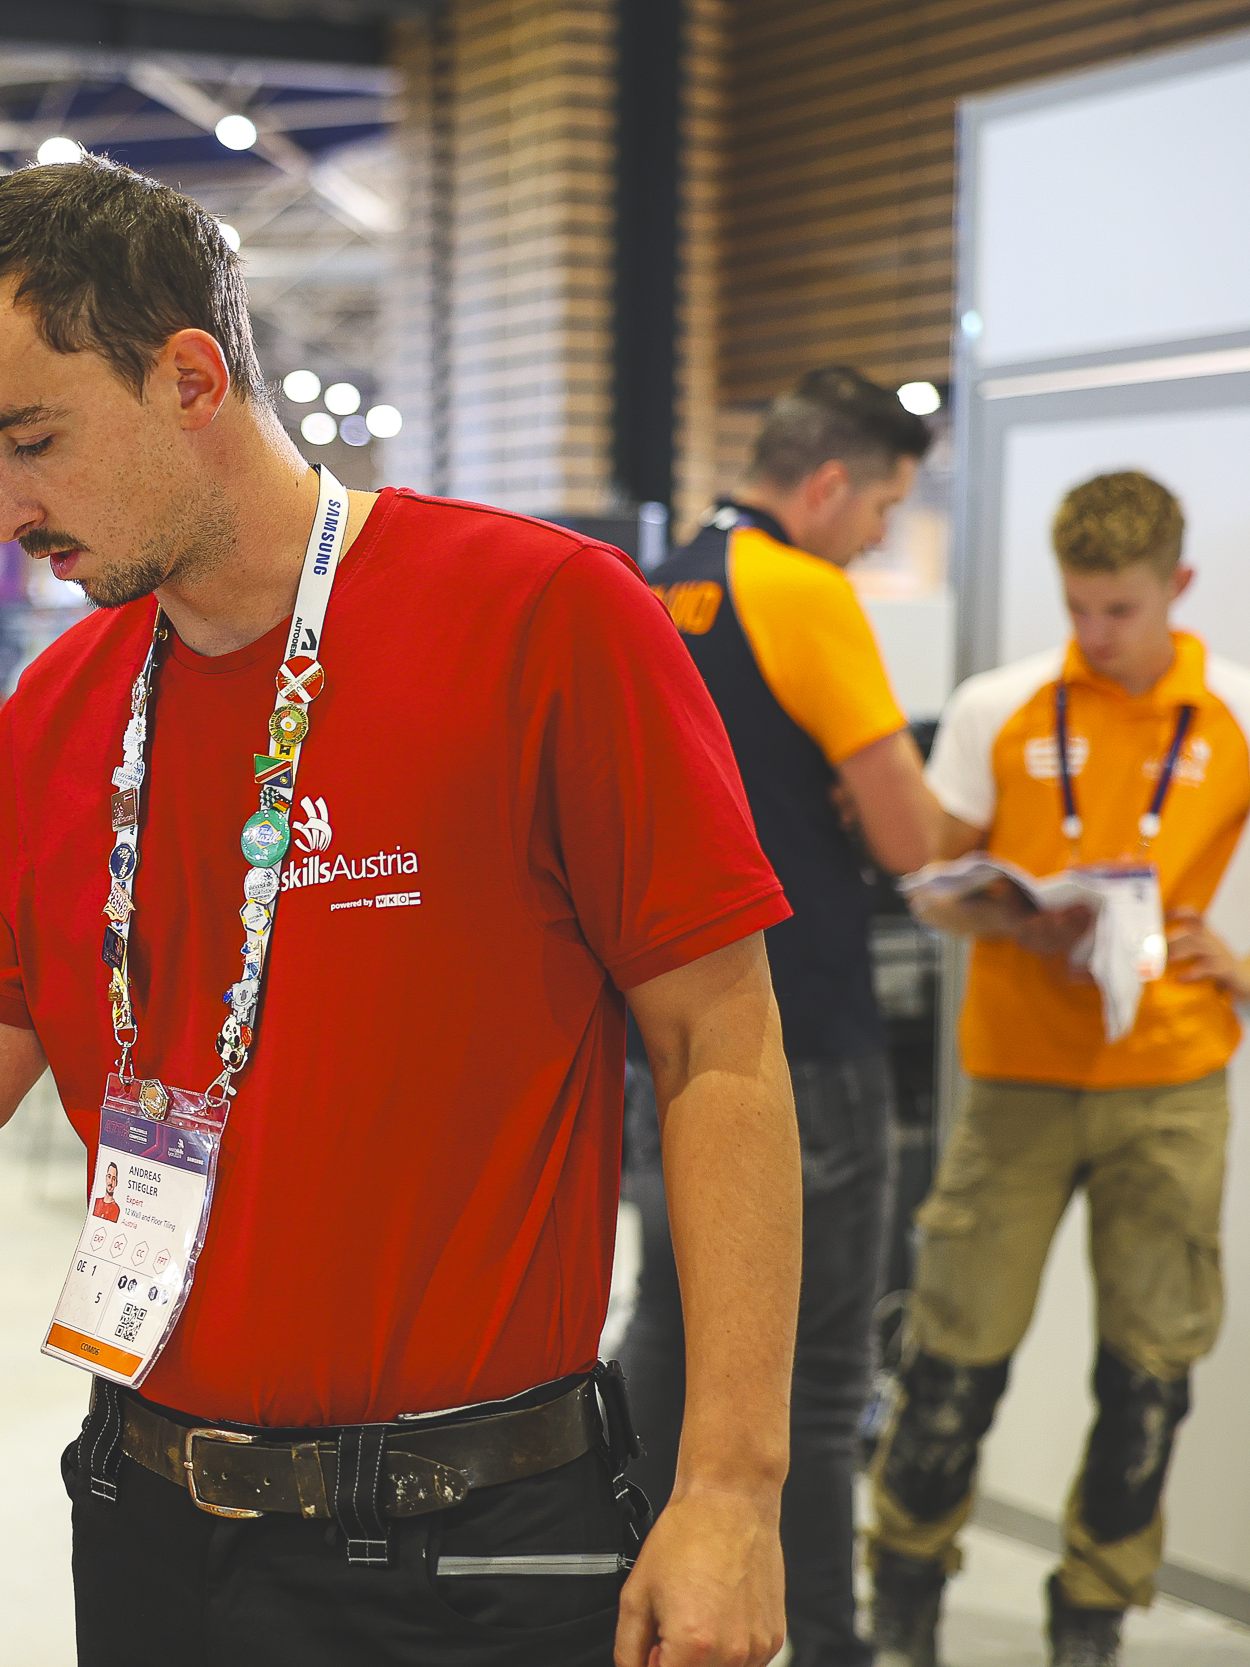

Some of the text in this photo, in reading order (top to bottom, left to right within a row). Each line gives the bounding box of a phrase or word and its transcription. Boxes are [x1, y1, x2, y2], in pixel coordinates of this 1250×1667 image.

[313, 499, 341, 576] SAMSUNG
[280, 845, 419, 892] skillsAustria
[107, 894, 125, 918] KONG
[111, 887, 128, 909] HONG
[330, 898, 362, 912] powered
[362, 898, 374, 908] by
[129, 1165, 161, 1183] ANDREAS
[127, 1179, 158, 1197] STIEGLER
[126, 1195, 144, 1207] Expert
[121, 1218, 138, 1230] Austria
[125, 1207, 176, 1233] 12 Wall and Floor Tiling
[93, 1234, 104, 1243] EXP
[136, 1249, 145, 1258] CC
[91, 1264, 97, 1277] 1
[94, 1292, 103, 1304] 5
